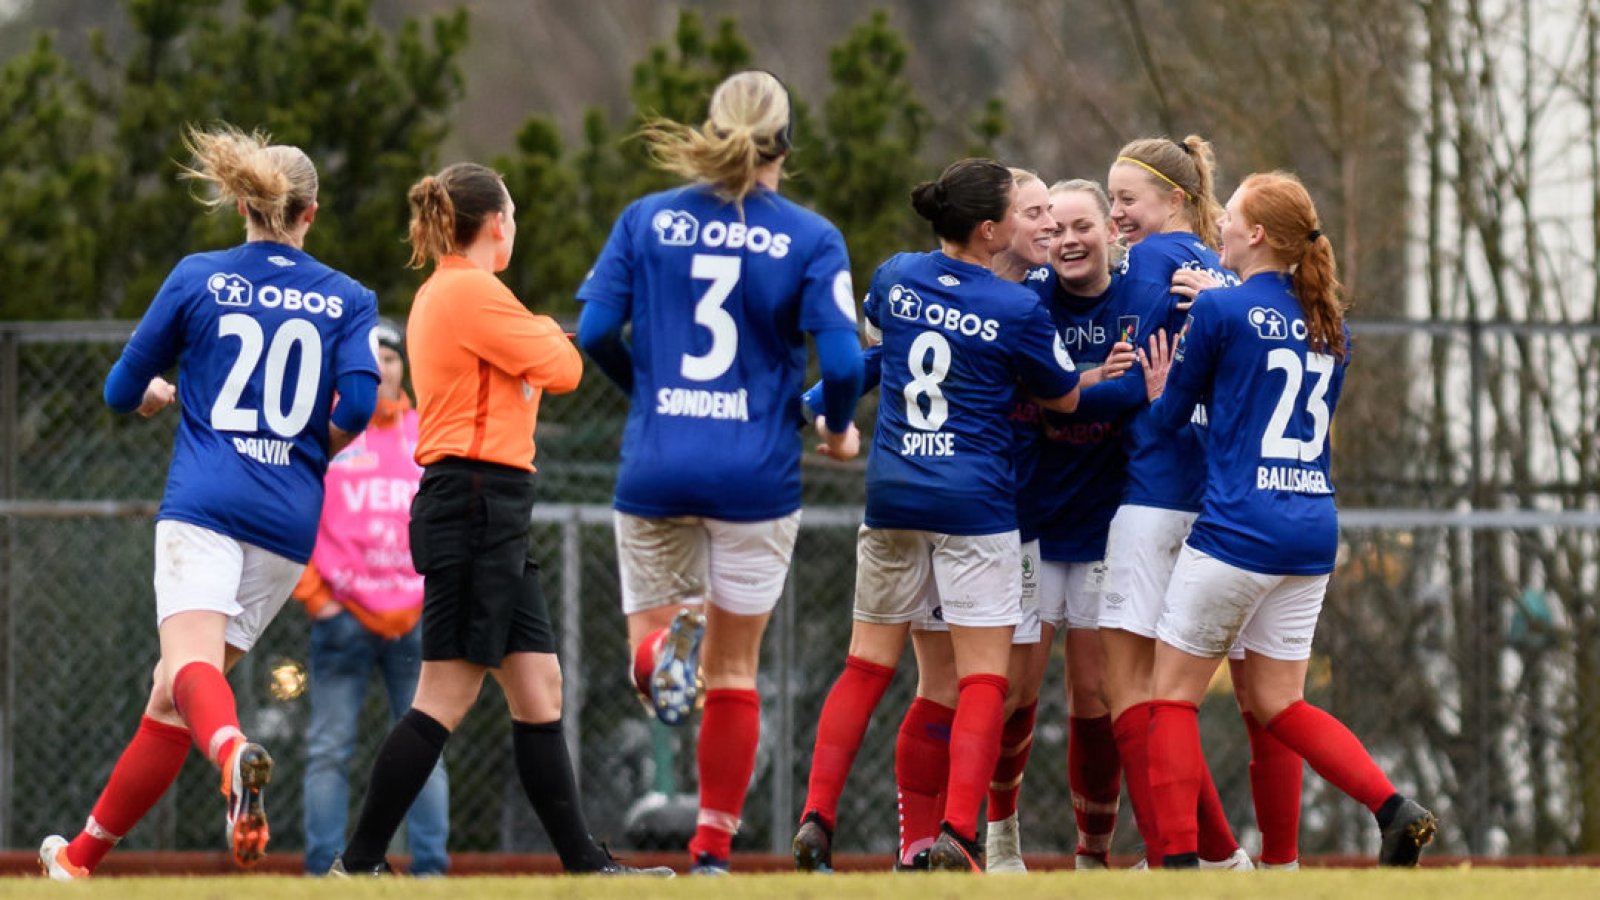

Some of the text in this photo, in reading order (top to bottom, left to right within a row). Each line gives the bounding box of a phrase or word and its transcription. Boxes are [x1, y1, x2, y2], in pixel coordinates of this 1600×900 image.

[701, 221, 792, 259] OBOS
[258, 285, 344, 319] OBOS
[680, 253, 742, 382] 3
[925, 304, 1000, 341] OBOS
[1065, 319, 1106, 350] DNB
[210, 313, 323, 438] 20
[903, 330, 952, 432] 8
[656, 388, 749, 422] SØNDENÅ
[1261, 348, 1336, 463] 23
[901, 432, 955, 457] SPITSE
